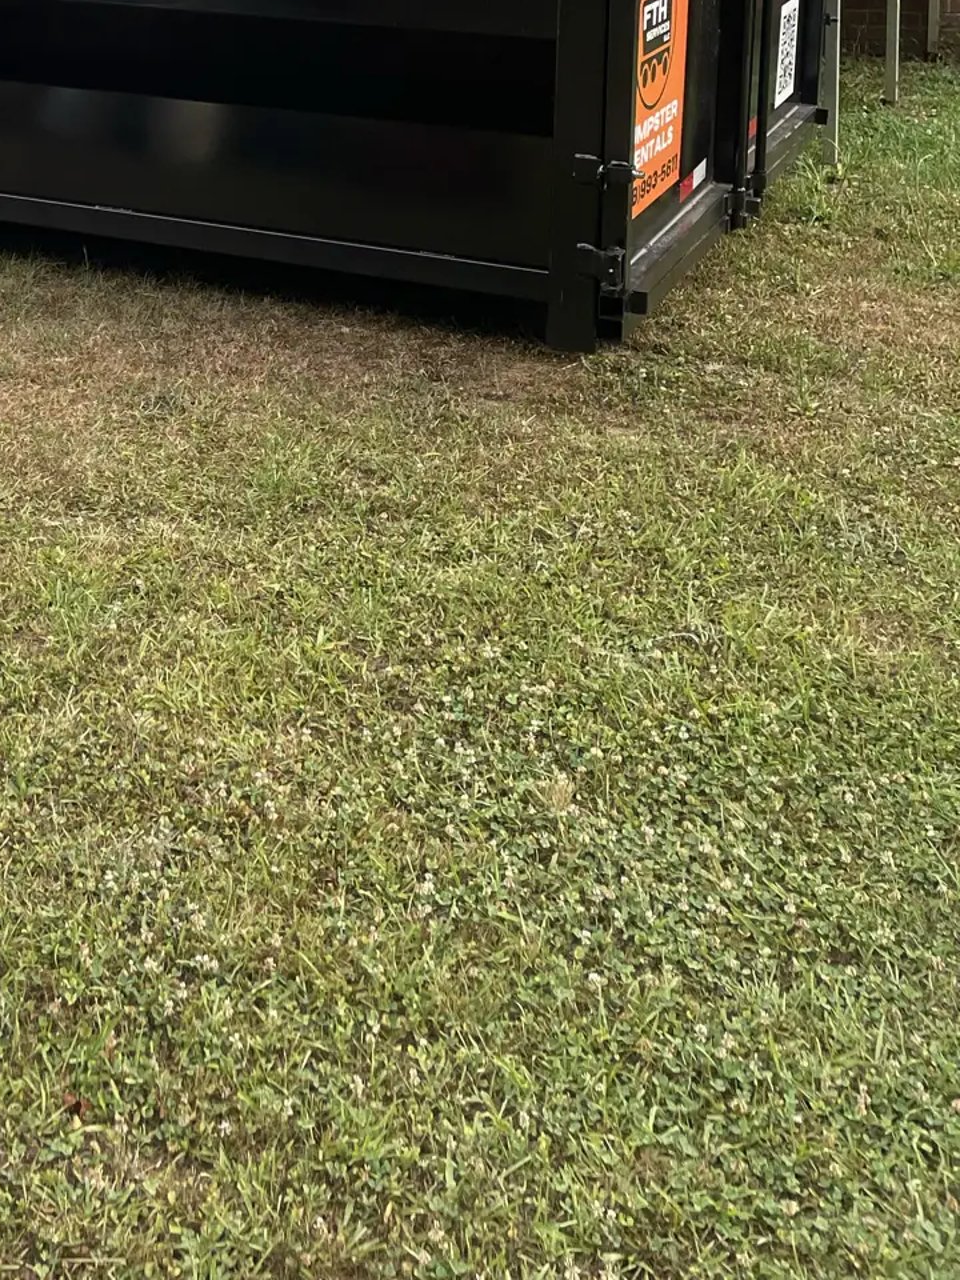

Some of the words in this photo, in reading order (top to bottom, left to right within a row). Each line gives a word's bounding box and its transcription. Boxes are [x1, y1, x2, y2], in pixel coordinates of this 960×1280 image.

[634, 99, 679, 145] MPSTER
[634, 125, 674, 170] ENTALS
[631, 153, 678, 207] 8)993-5611
